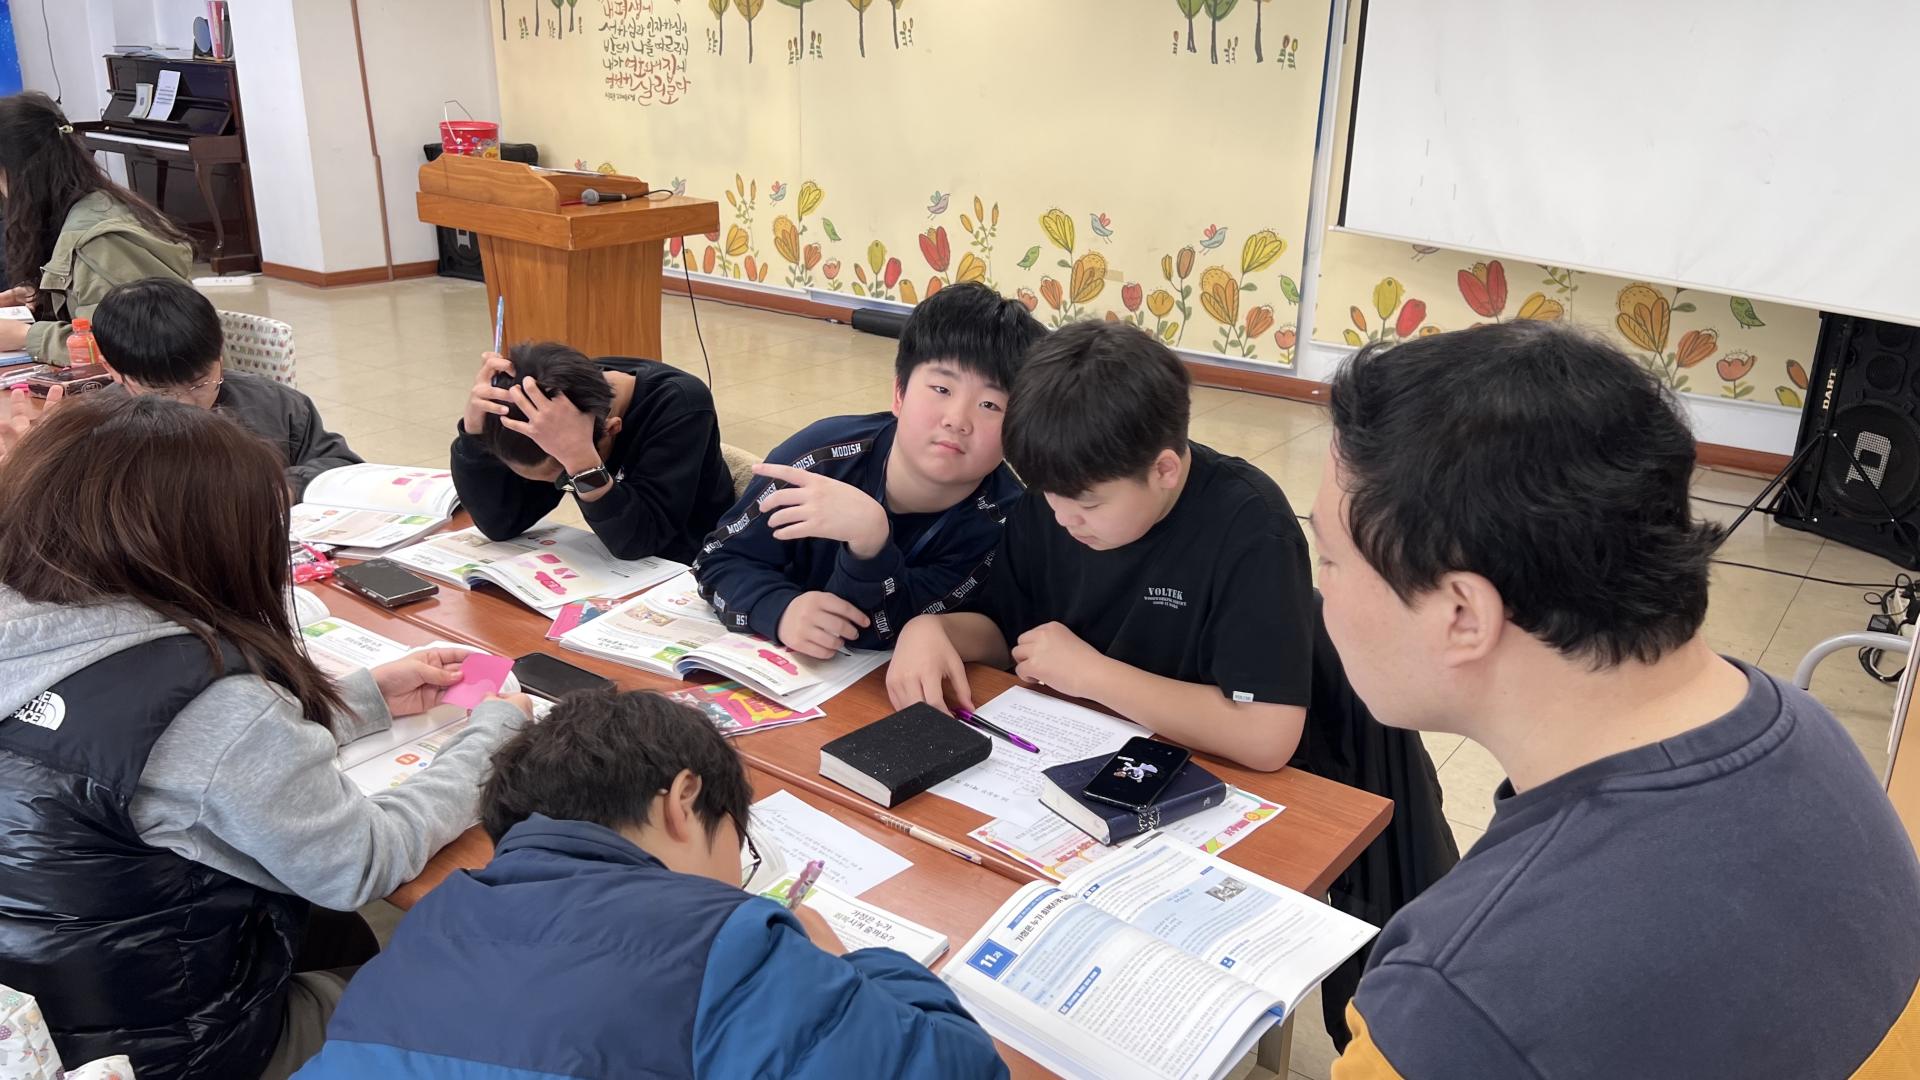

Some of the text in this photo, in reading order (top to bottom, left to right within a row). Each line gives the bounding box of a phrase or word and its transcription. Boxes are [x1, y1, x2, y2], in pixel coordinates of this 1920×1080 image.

[598, 13, 687, 39] 선하심과 인자하심이
[604, 37, 629, 56] 반드시
[631, 38, 654, 57] 나를
[602, 56, 624, 71] 내가
[1823, 369, 1837, 409] DART
[831, 443, 862, 458] MODISH
[1149, 587, 1183, 600] VOLTEK
